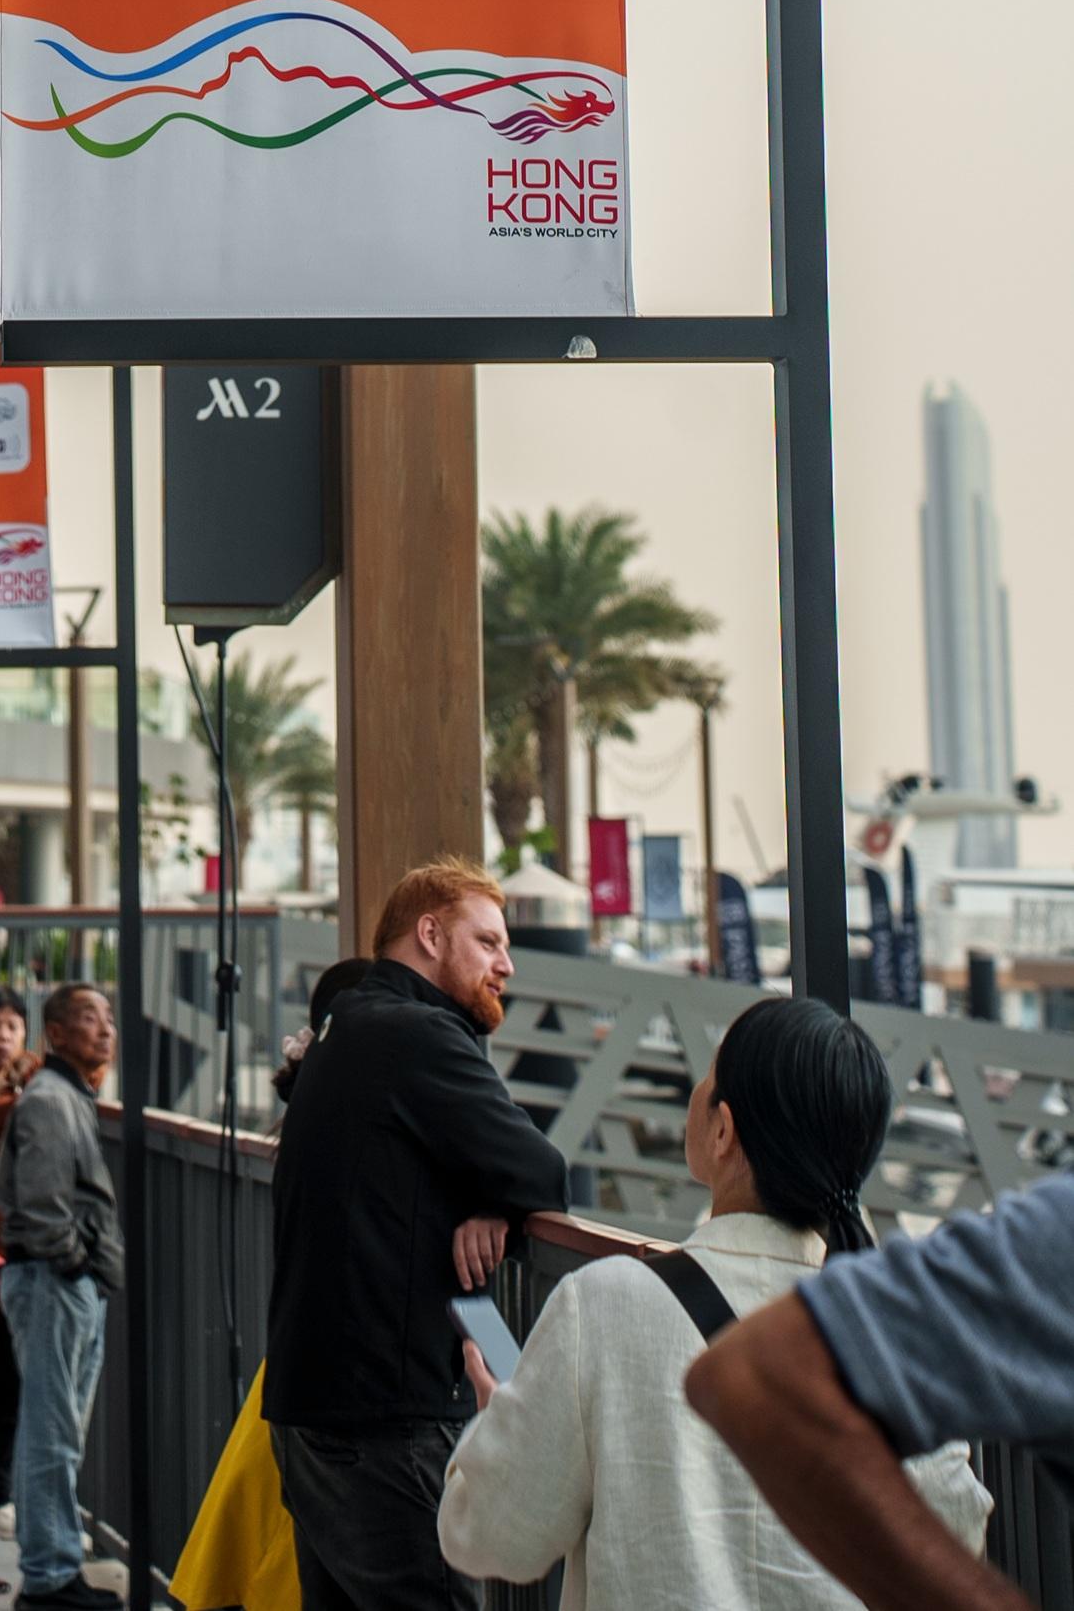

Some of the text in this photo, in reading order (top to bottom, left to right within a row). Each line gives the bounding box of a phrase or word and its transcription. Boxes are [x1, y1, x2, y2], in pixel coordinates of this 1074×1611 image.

[488, 158, 618, 190] HONG
[488, 193, 618, 224] KONG
[489, 227, 618, 238] ASIA'S WORLD CITY
